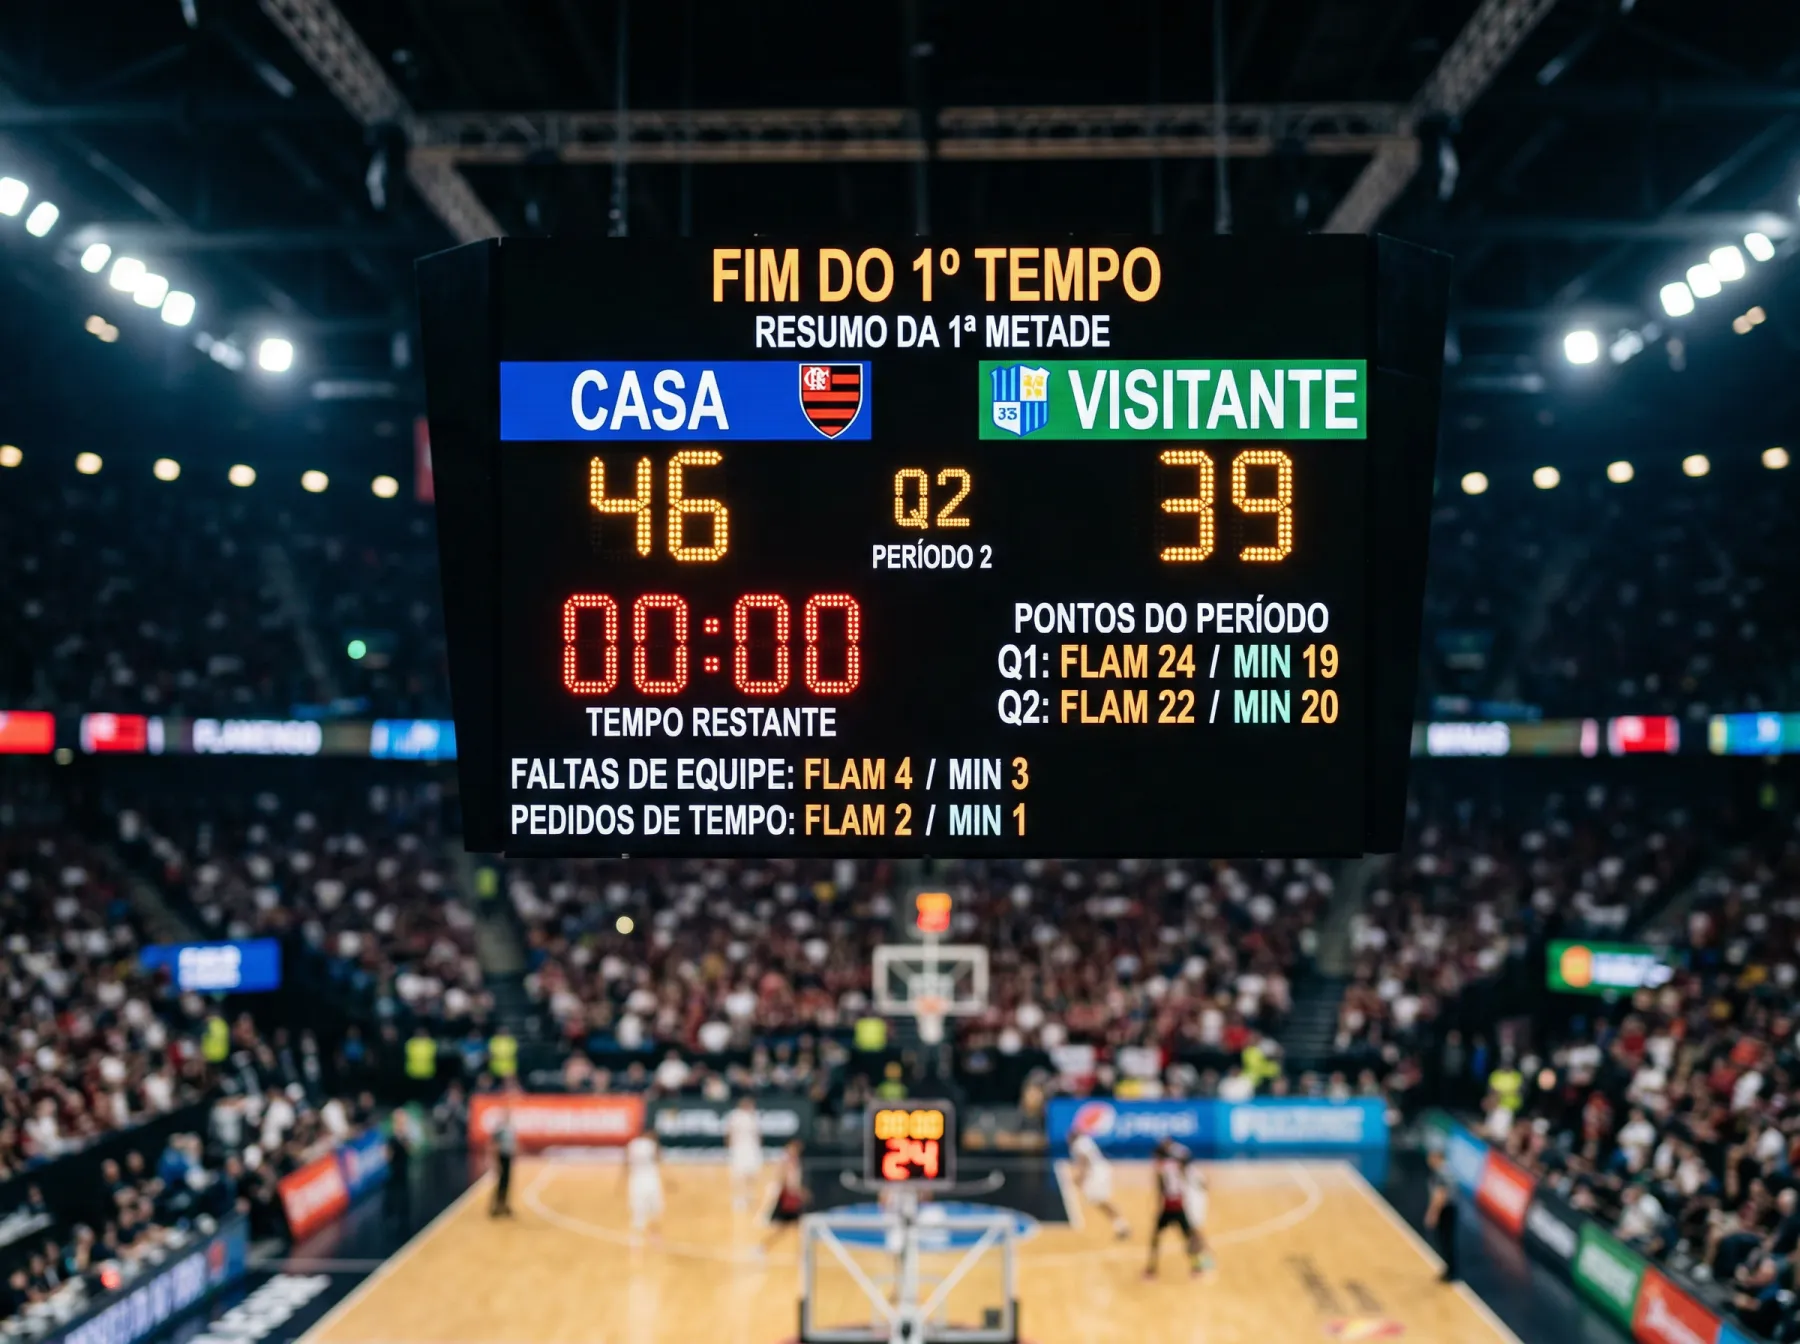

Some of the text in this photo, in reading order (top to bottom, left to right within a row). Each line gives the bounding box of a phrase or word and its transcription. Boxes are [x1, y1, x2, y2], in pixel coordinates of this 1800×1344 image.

[713, 246, 1162, 303] FIM DO 1º TEMPO
[755, 314, 1111, 349] RESUMO DA 1ª METADE
[571, 369, 729, 431] CASA
[1068, 368, 1358, 430] VISITANTE
[588, 449, 730, 563] 46
[893, 467, 972, 530] Q2
[1159, 449, 1294, 563] 39
[872, 539, 993, 570] PERÍODO 2
[1014, 594, 1329, 634] PONTOS DO PERÍODO
[562, 592, 862, 697] 00:00
[997, 643, 1339, 681] Q1: FLAM 24 / MIN 19
[585, 706, 837, 738] TEMPO RESTANTE
[997, 688, 1339, 727] Q2: FLAM 22 / MIN 20
[511, 756, 1029, 794] FALTAS DE EQUIPE: FLAM 4 / MIN 3
[511, 802, 1025, 837] PEDIDOS DE TEMPO: FLAM 2 / MIN 1
[882, 1138, 940, 1181] 24
